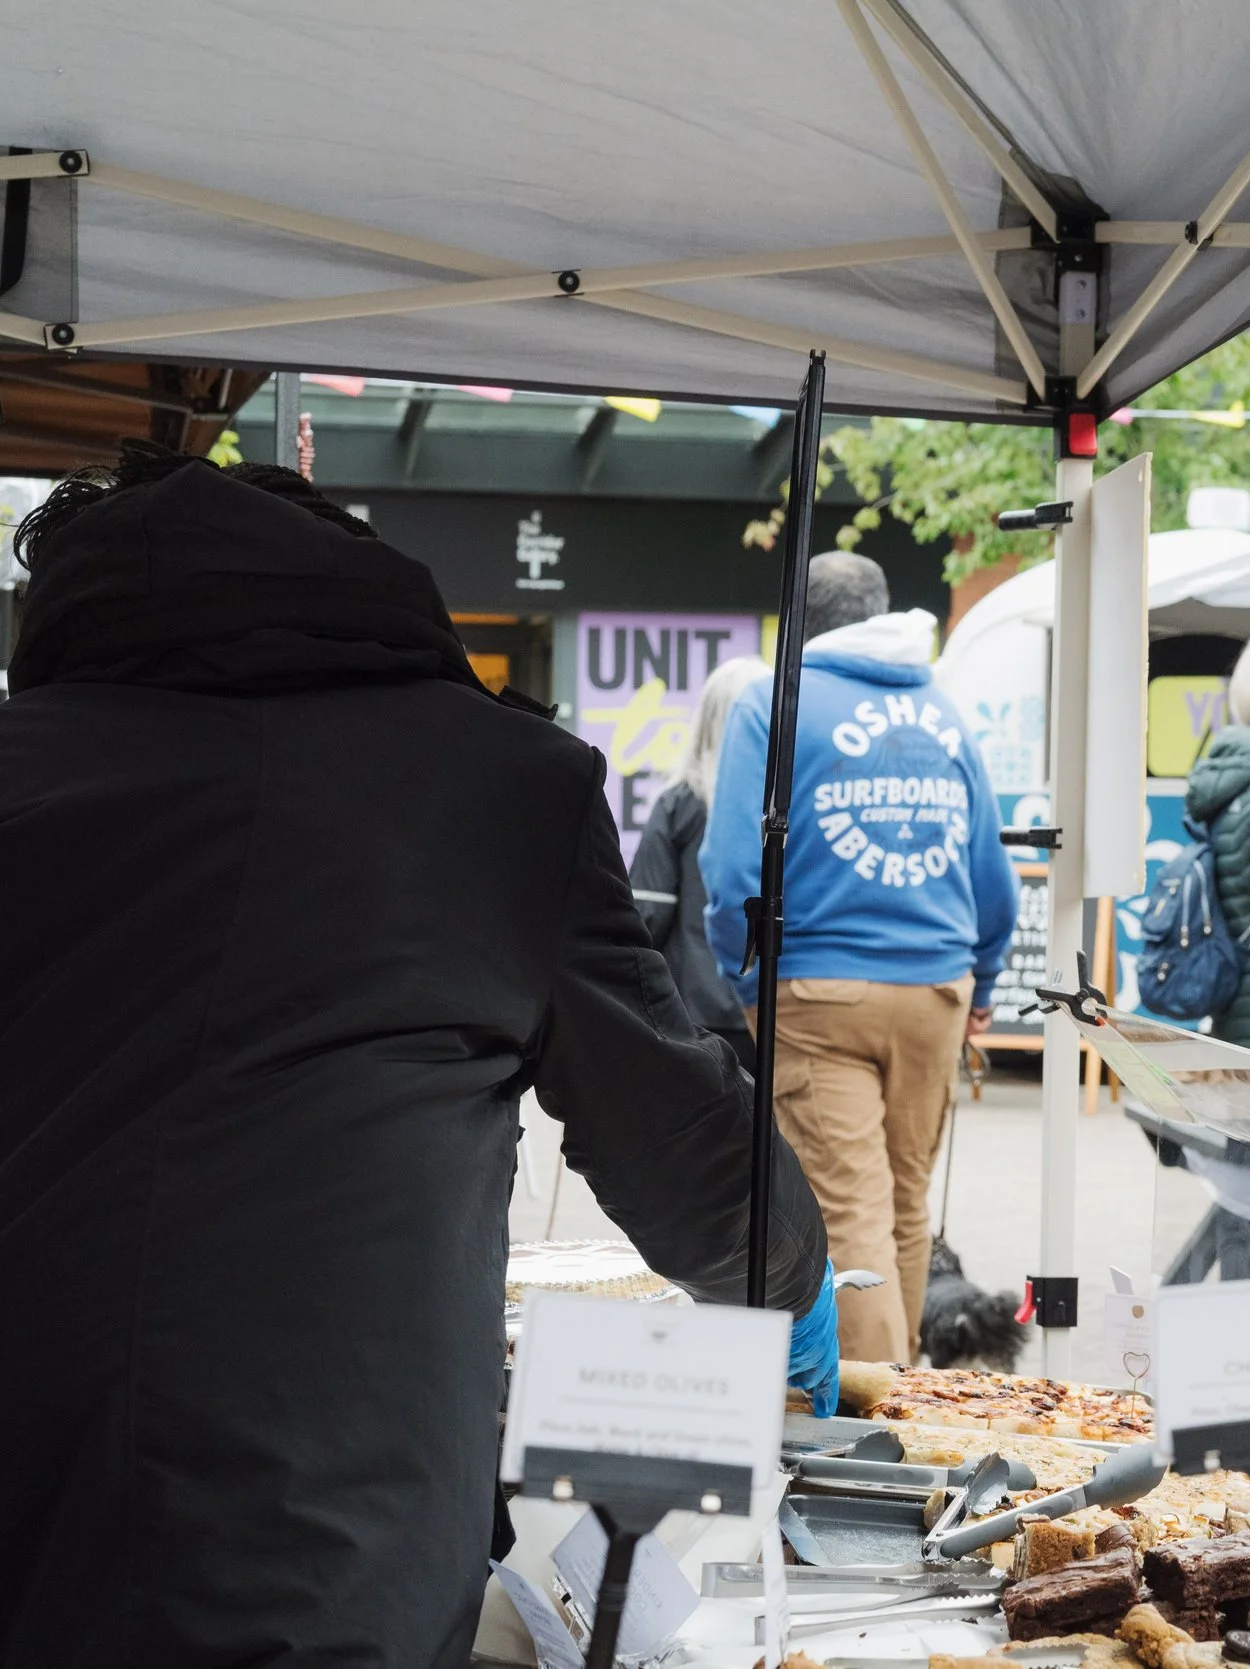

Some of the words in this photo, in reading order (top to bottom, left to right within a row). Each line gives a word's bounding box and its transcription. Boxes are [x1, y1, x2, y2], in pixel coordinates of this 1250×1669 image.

[588, 627, 730, 690] UNIT
[578, 1366, 648, 1391] MIXED
[653, 1372, 730, 1396] OLIVES
